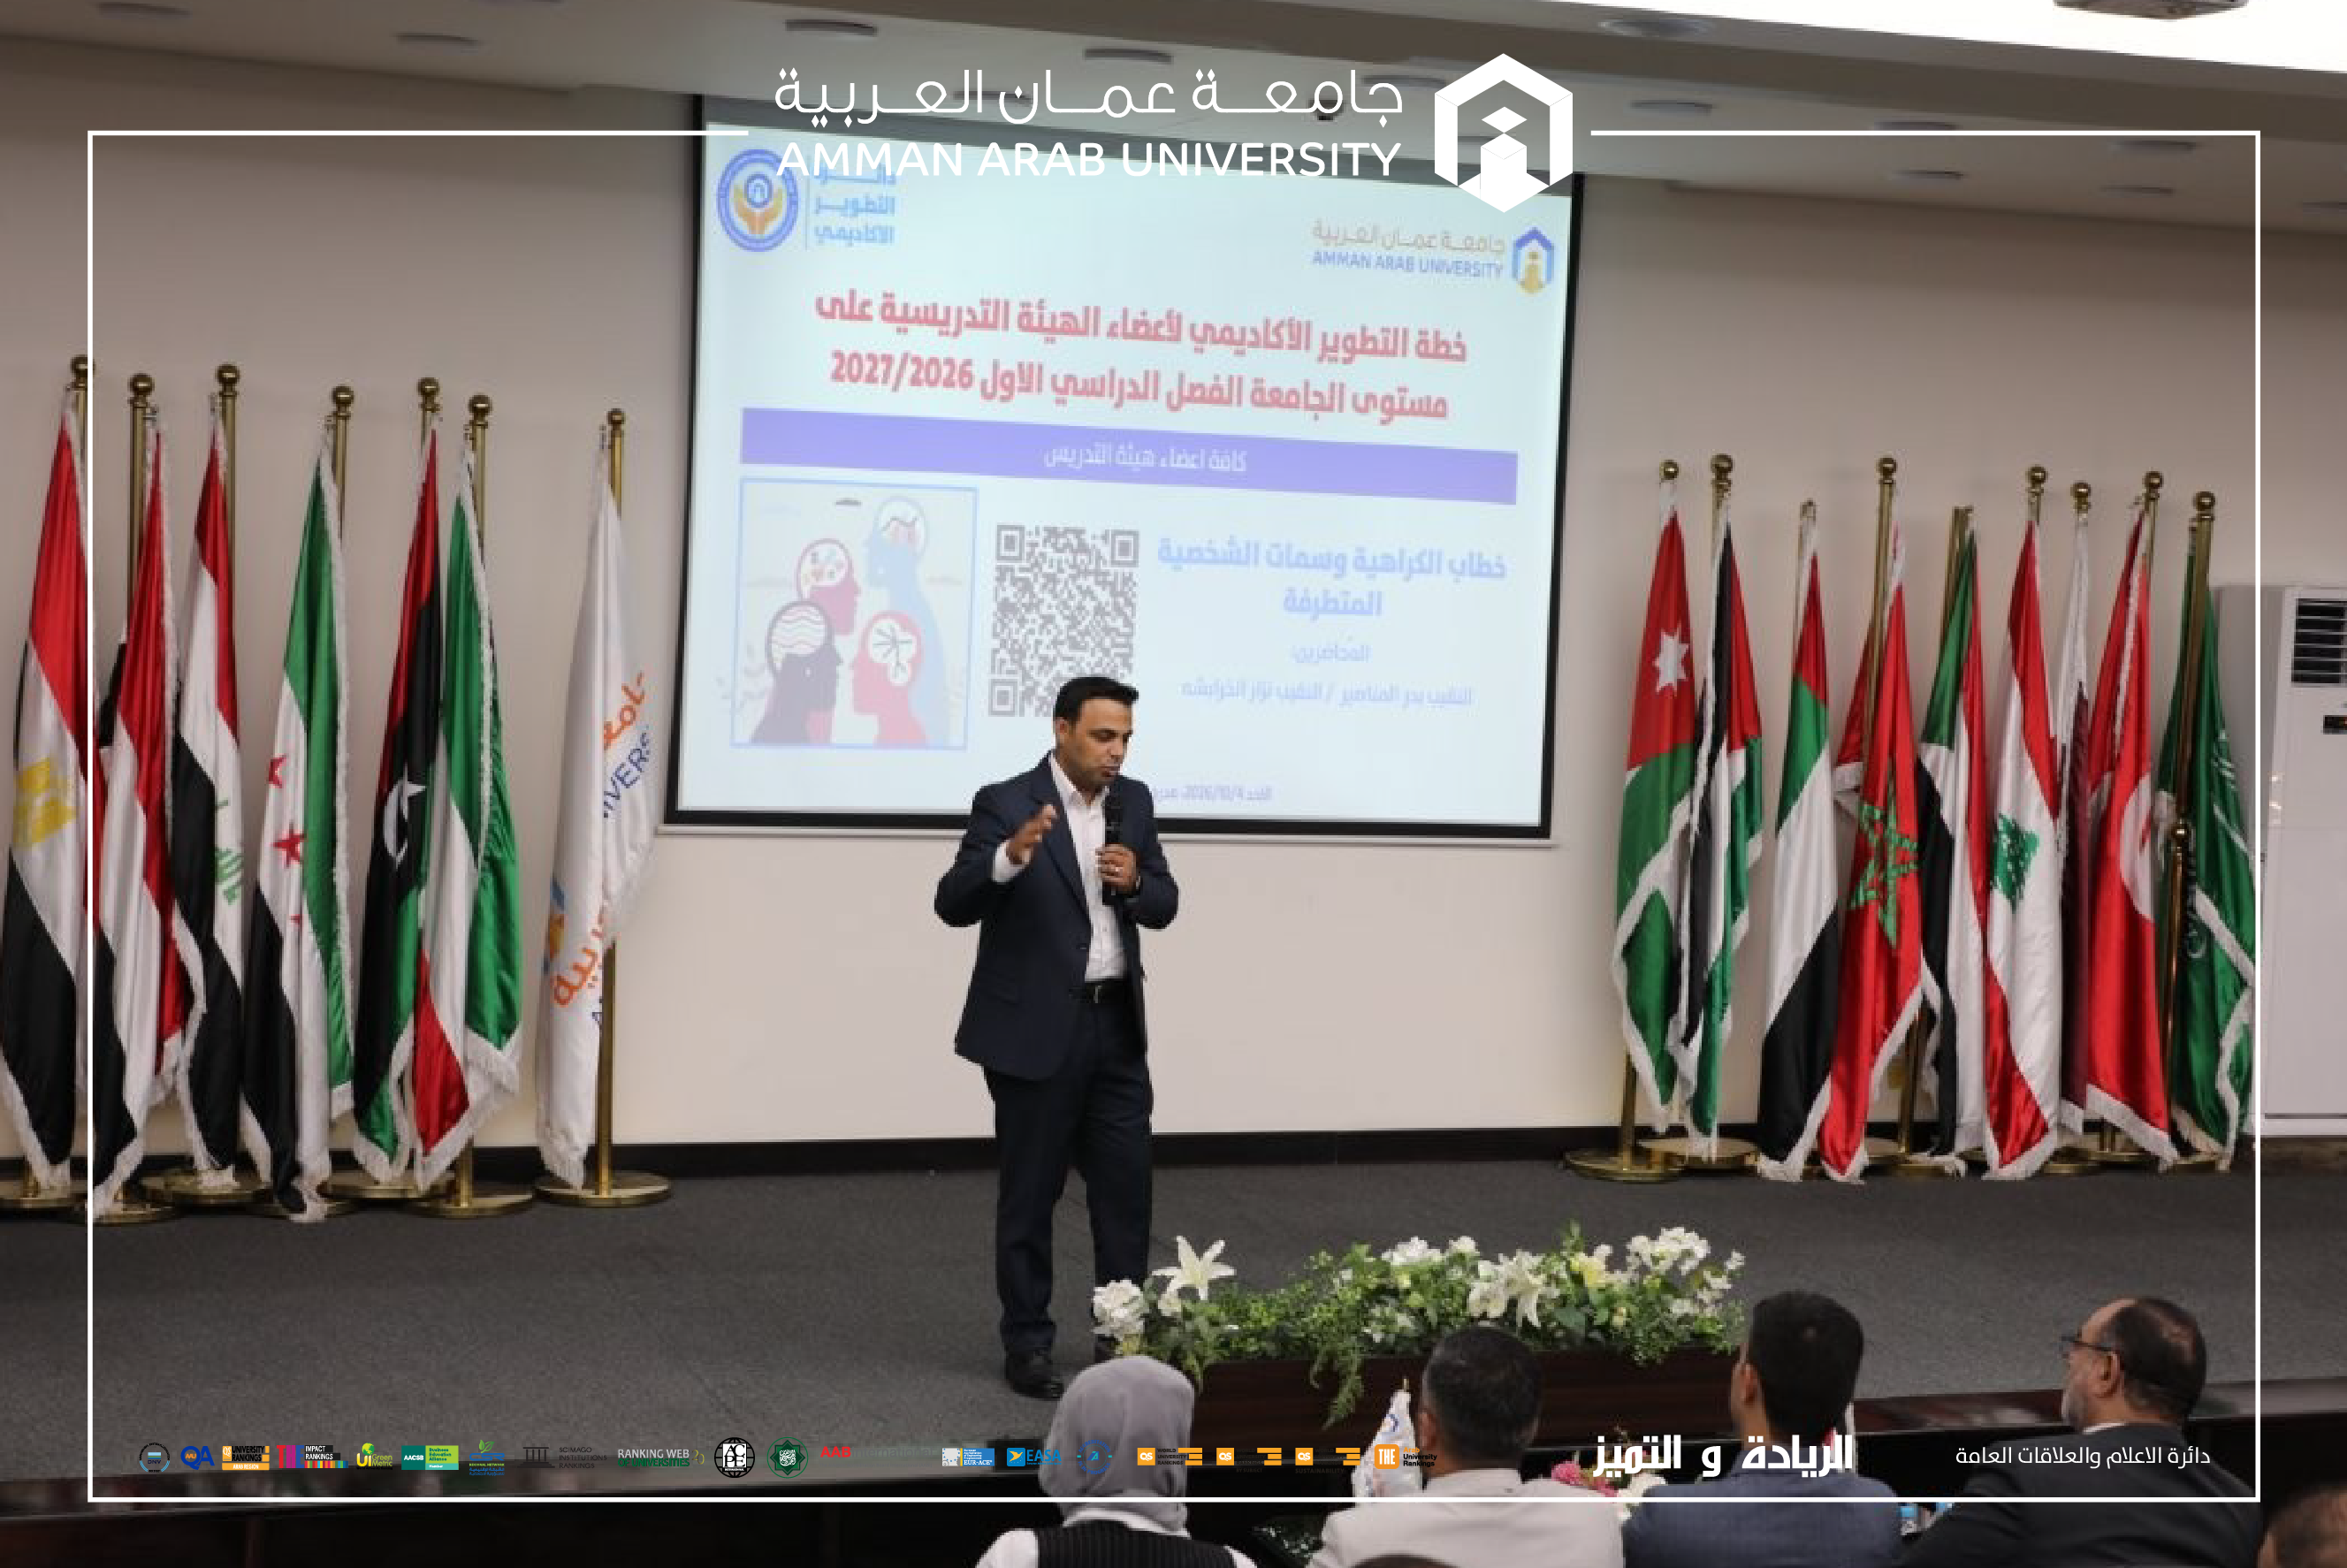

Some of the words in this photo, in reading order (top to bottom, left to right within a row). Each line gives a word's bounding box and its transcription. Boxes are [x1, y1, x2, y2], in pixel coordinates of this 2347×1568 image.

[1312, 251, 1372, 270] AMMAN
[1375, 256, 1414, 274] ARAB
[1418, 260, 1503, 278] UNIVERSITY
[815, 288, 873, 323] على
[879, 292, 1010, 339] التدريسية
[1017, 298, 1100, 344] الهيئة
[1316, 323, 1409, 364] التطوير
[1414, 327, 1467, 364] خطة
[1049, 366, 1161, 409] الدراسي
[1165, 369, 1244, 413] الفصل
[1250, 377, 1345, 421] الجامعة
[1157, 534, 1261, 573] الشخصية
[1264, 542, 1348, 582] وسمات
[1353, 545, 1444, 583] الكراهية
[1448, 550, 1507, 584] خطاب
[1283, 586, 1383, 623] المتطرفة
